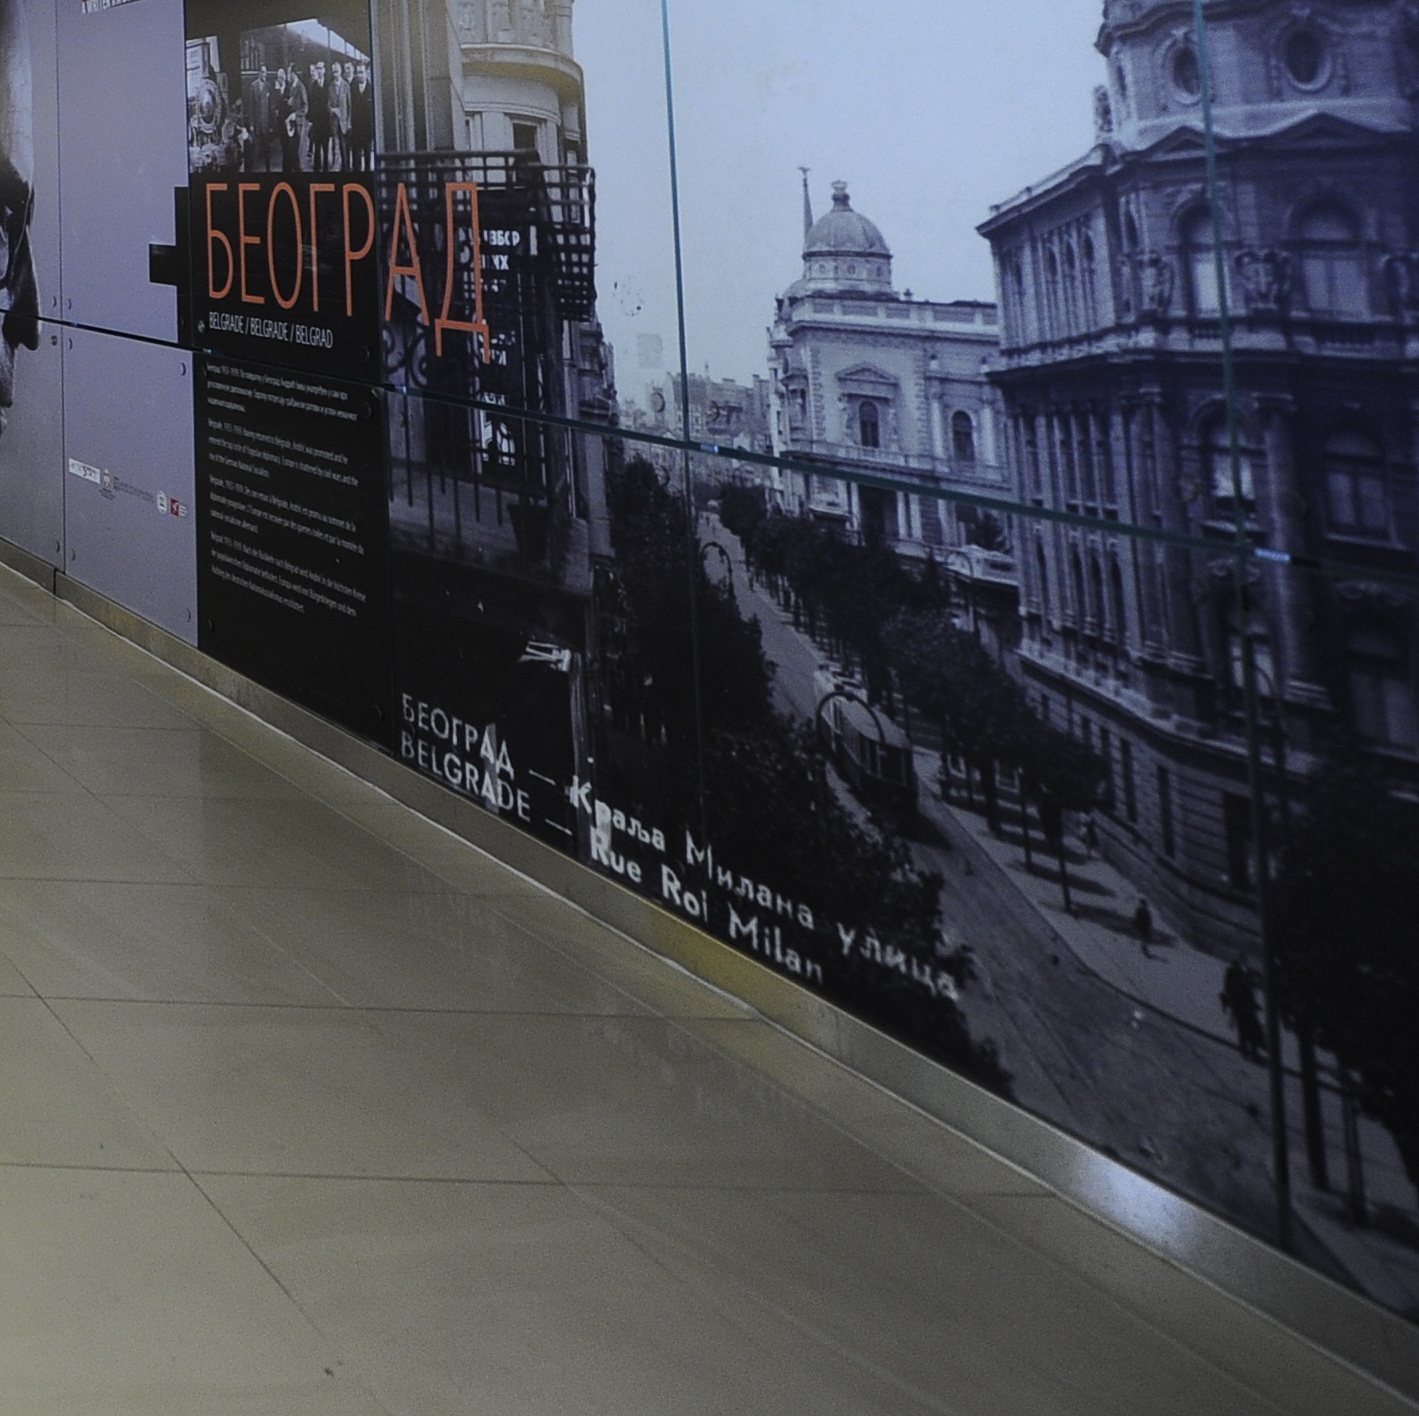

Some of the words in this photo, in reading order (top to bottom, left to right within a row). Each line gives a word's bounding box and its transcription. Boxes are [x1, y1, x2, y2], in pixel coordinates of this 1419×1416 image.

[206, 182, 490, 364] БЕОГРАД
[209, 311, 244, 334] BELGRADE
[250, 317, 289, 342] BELGRADE
[295, 325, 334, 349] BELGRAD
[401, 730, 531, 823] BELGRADE
[590, 825, 643, 884] Rue
[661, 863, 710, 924] Roi
[728, 902, 825, 984] Milan
[402, 693, 515, 781] БЕОГРАД
[569, 775, 666, 852] Краља
[685, 829, 816, 930] Милана
[838, 922, 960, 1002] улица
